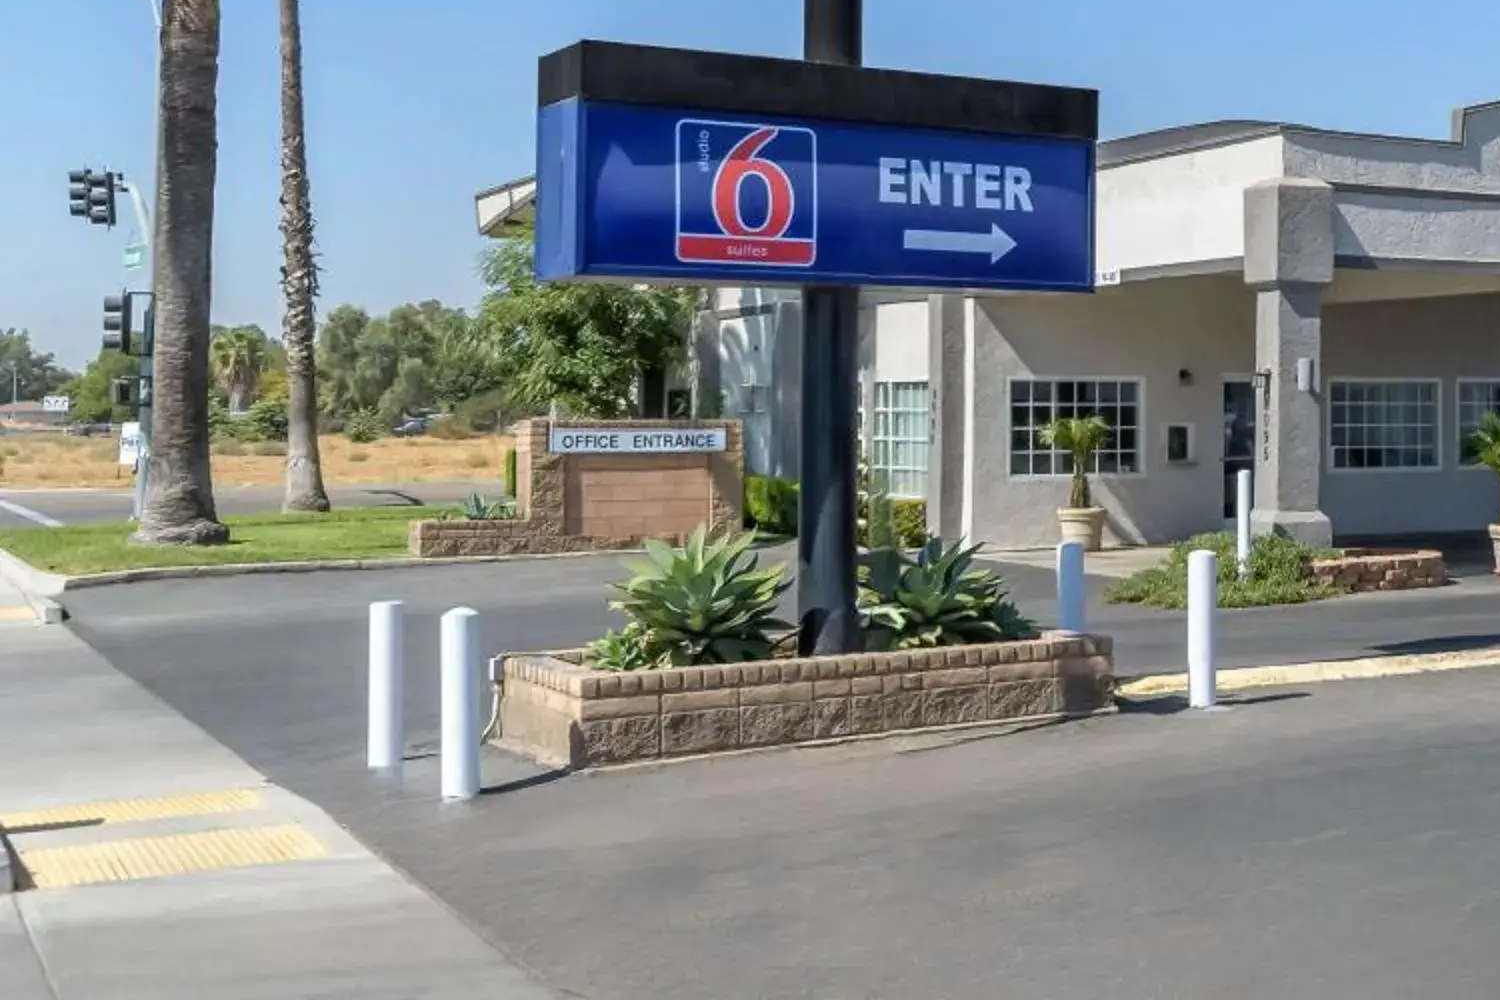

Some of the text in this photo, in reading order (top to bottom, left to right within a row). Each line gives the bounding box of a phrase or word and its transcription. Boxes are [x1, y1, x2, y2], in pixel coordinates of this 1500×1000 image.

[712, 126, 794, 239] 6
[879, 157, 1033, 212] ENTER
[726, 244, 769, 257] suites
[561, 434, 717, 449] OFFICE ENTRANCE
